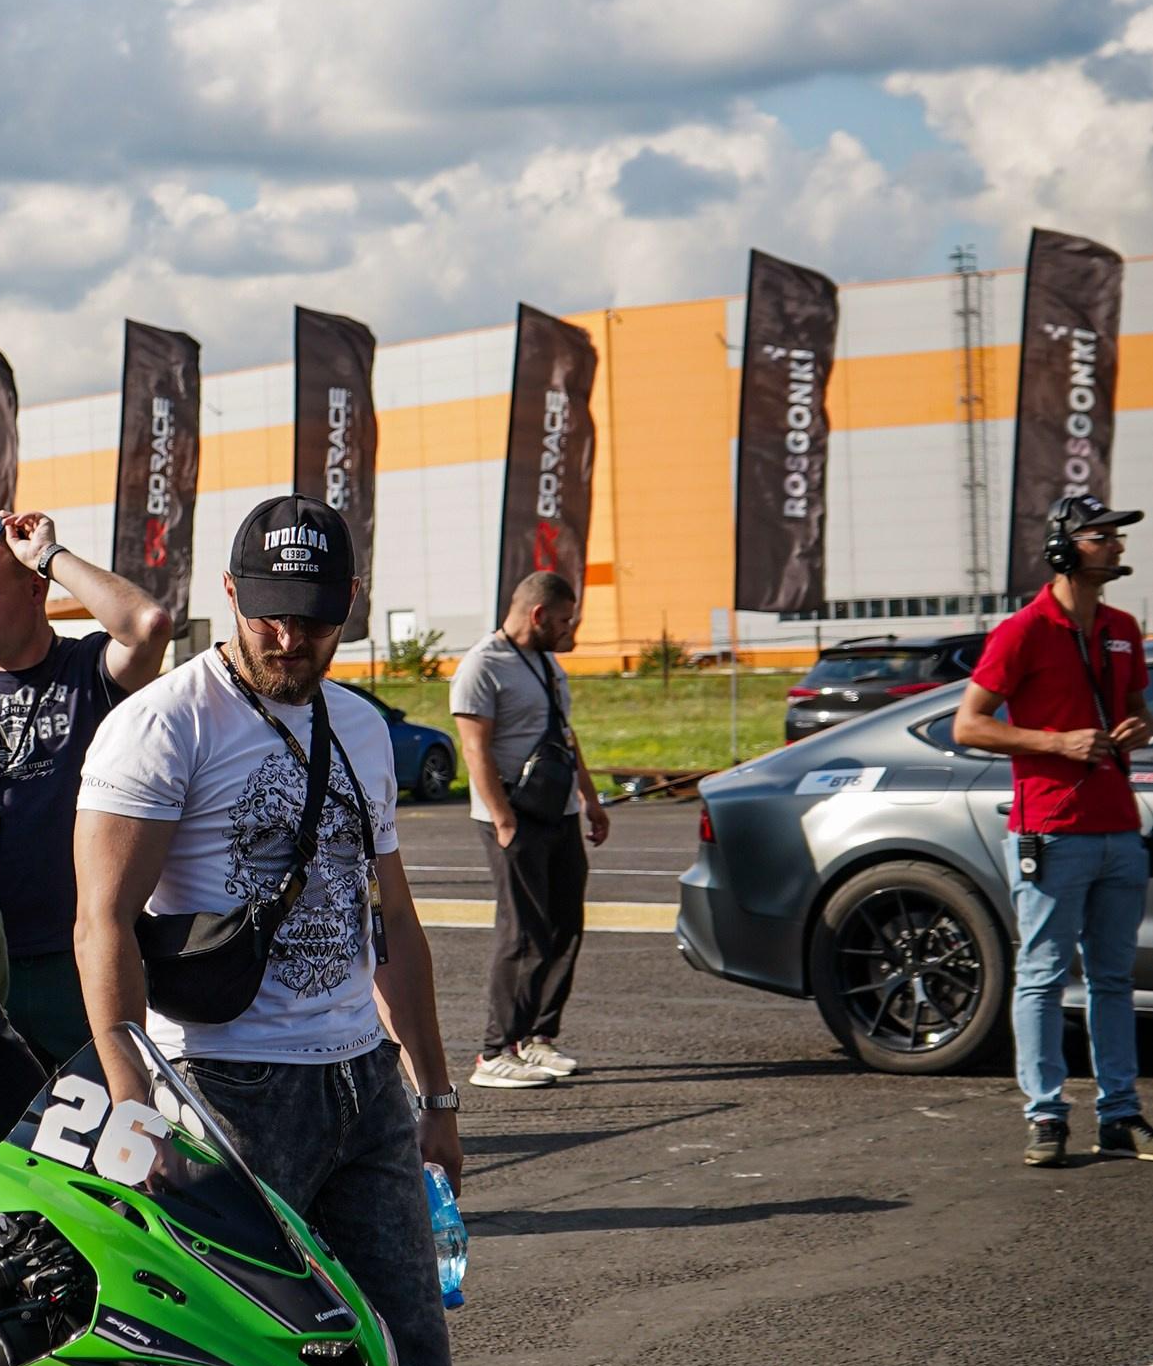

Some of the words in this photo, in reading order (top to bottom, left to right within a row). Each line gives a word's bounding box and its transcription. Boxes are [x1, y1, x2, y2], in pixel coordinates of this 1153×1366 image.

[783, 348, 815, 518] ROSGONKI
[1063, 327, 1097, 498] ROSGONKI
[271, 562, 320, 573] ATHLETICS
[31, 1074, 169, 1186] 26
[314, 1306, 349, 1323] Kawasaki
